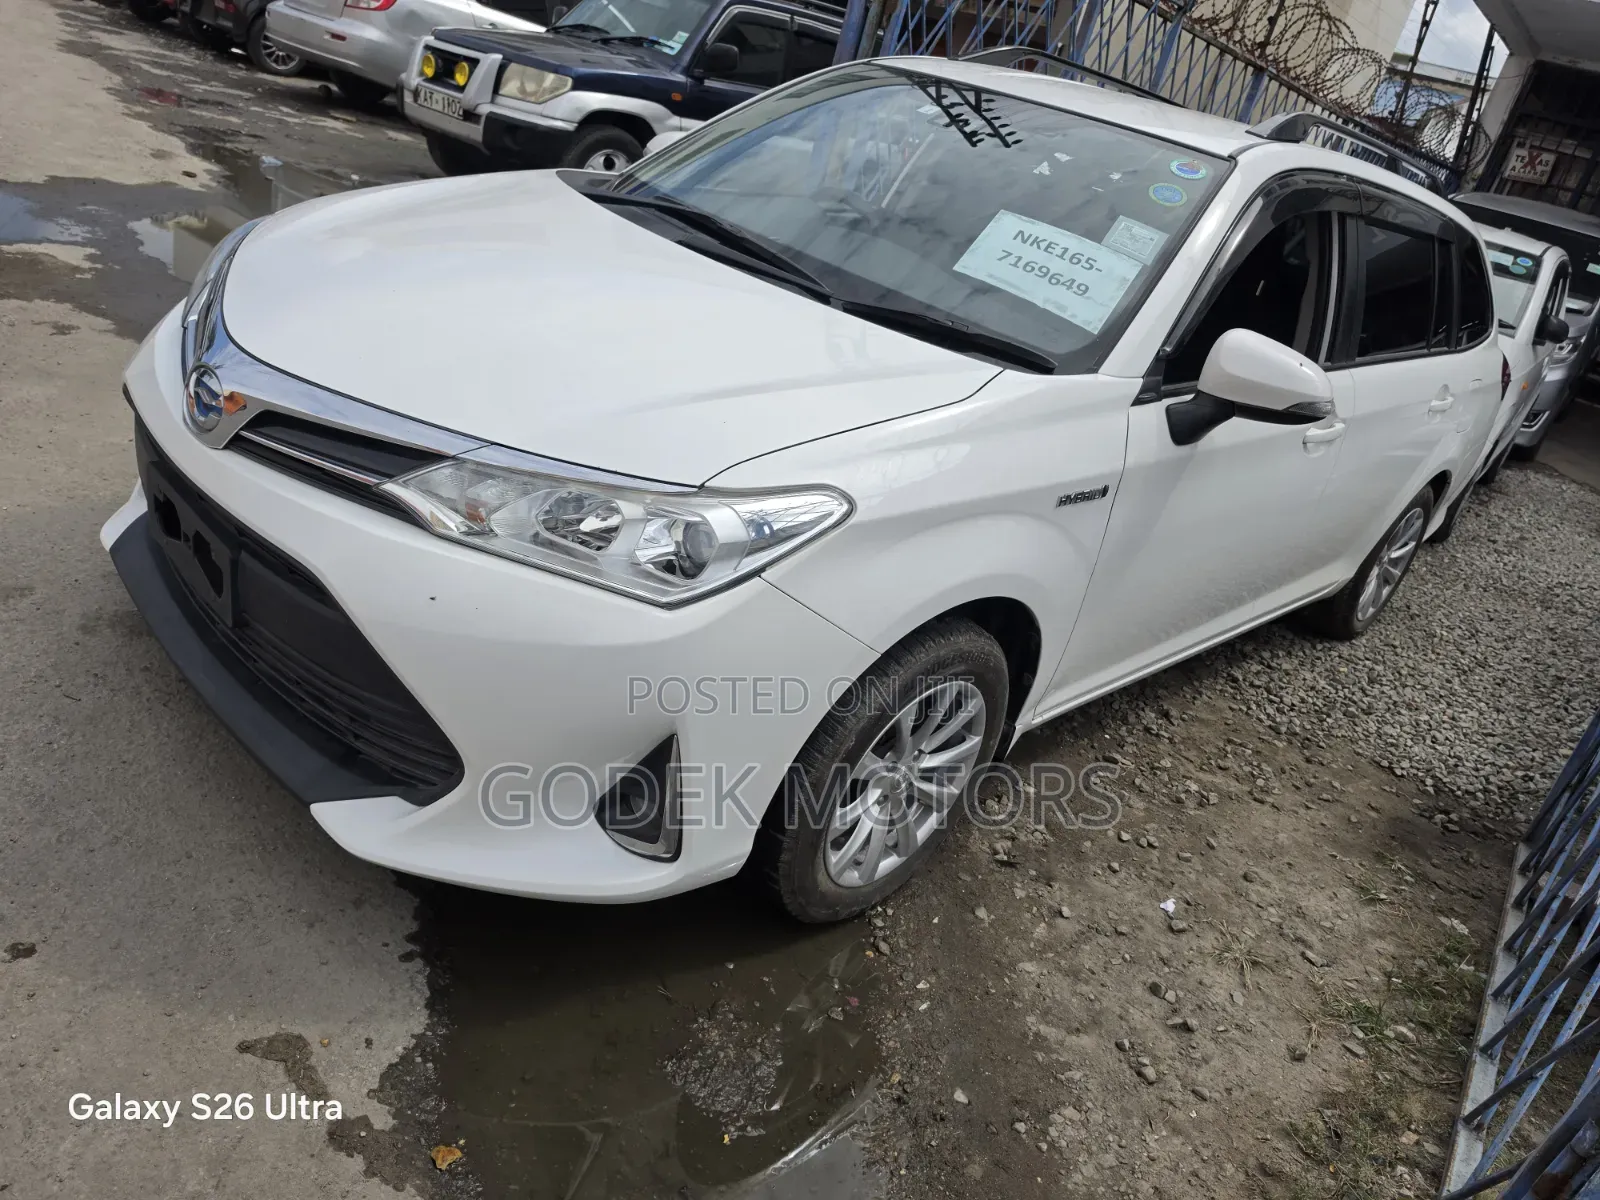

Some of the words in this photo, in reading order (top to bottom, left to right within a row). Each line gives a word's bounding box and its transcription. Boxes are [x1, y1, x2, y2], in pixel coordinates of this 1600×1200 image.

[1514, 150, 1551, 171] TEXAS
[1012, 229, 1103, 274] NKE165-
[996, 249, 1090, 297] 7169649
[1056, 486, 1107, 508] HYBRID
